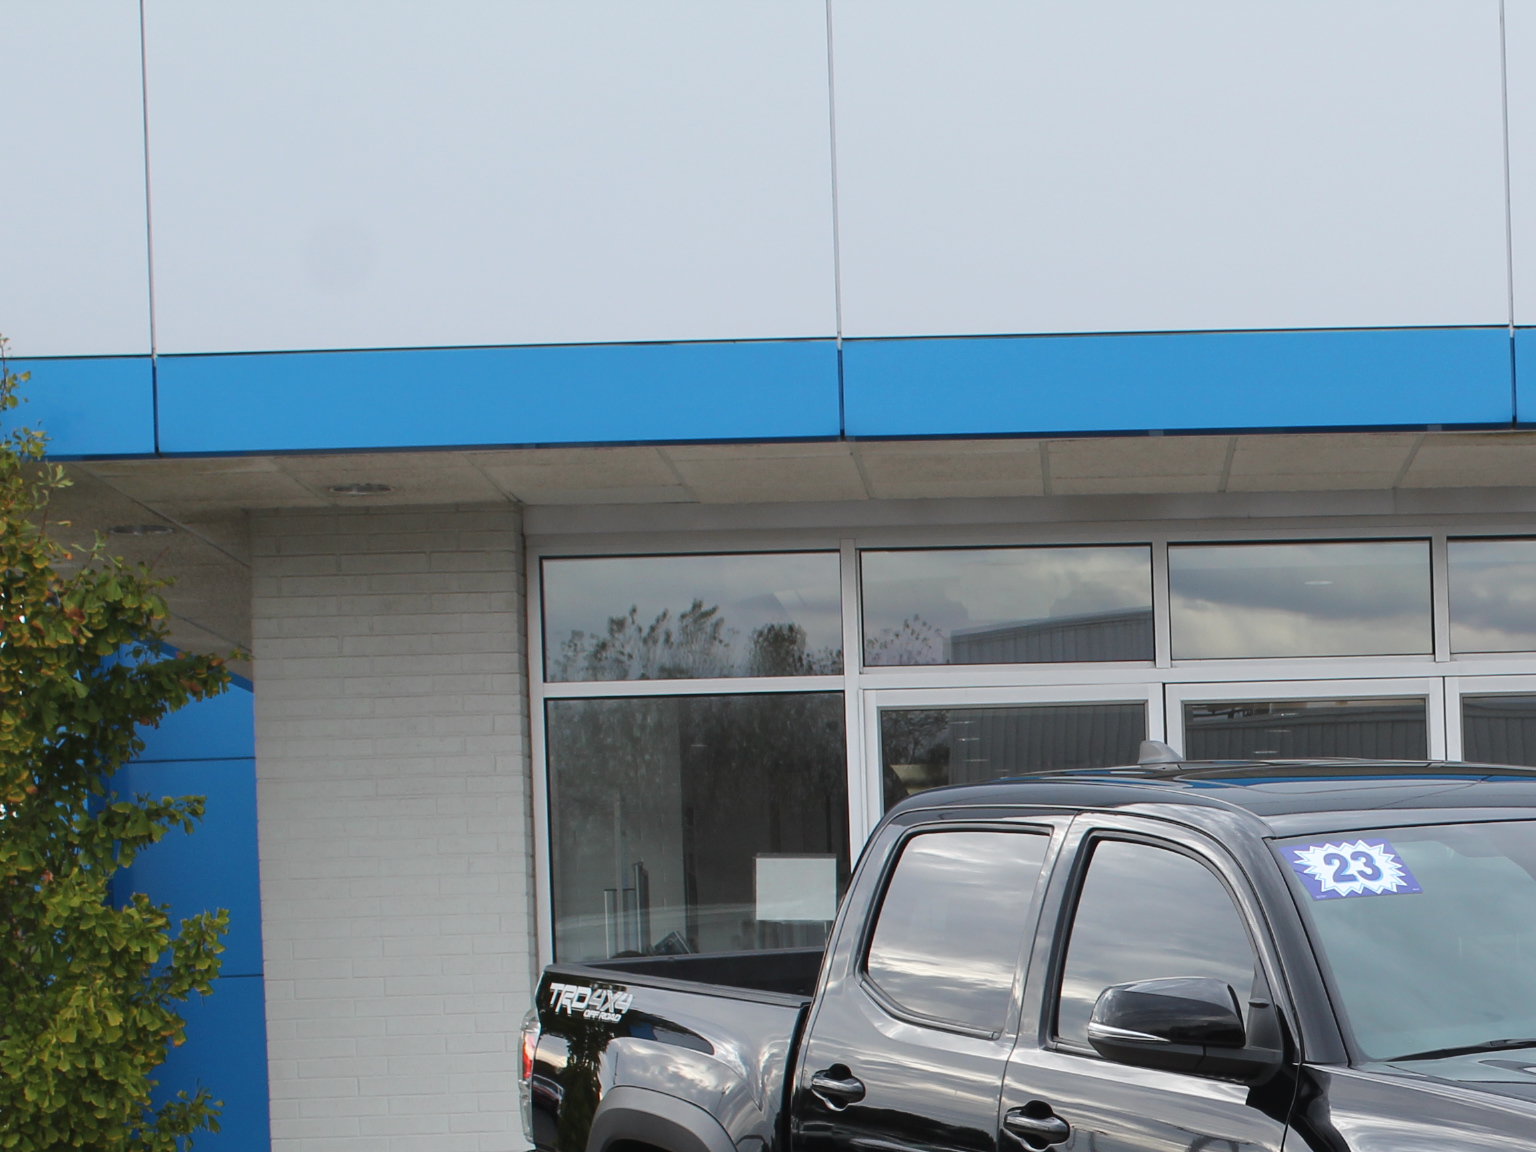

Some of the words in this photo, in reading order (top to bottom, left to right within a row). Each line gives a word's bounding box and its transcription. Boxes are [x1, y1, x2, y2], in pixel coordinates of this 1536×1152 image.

[1322, 850, 1384, 883] 23
[549, 982, 592, 1015] TRD
[589, 988, 633, 1014] 4X4
[583, 1009, 600, 1019] OFF
[598, 1011, 622, 1022] ROAD
